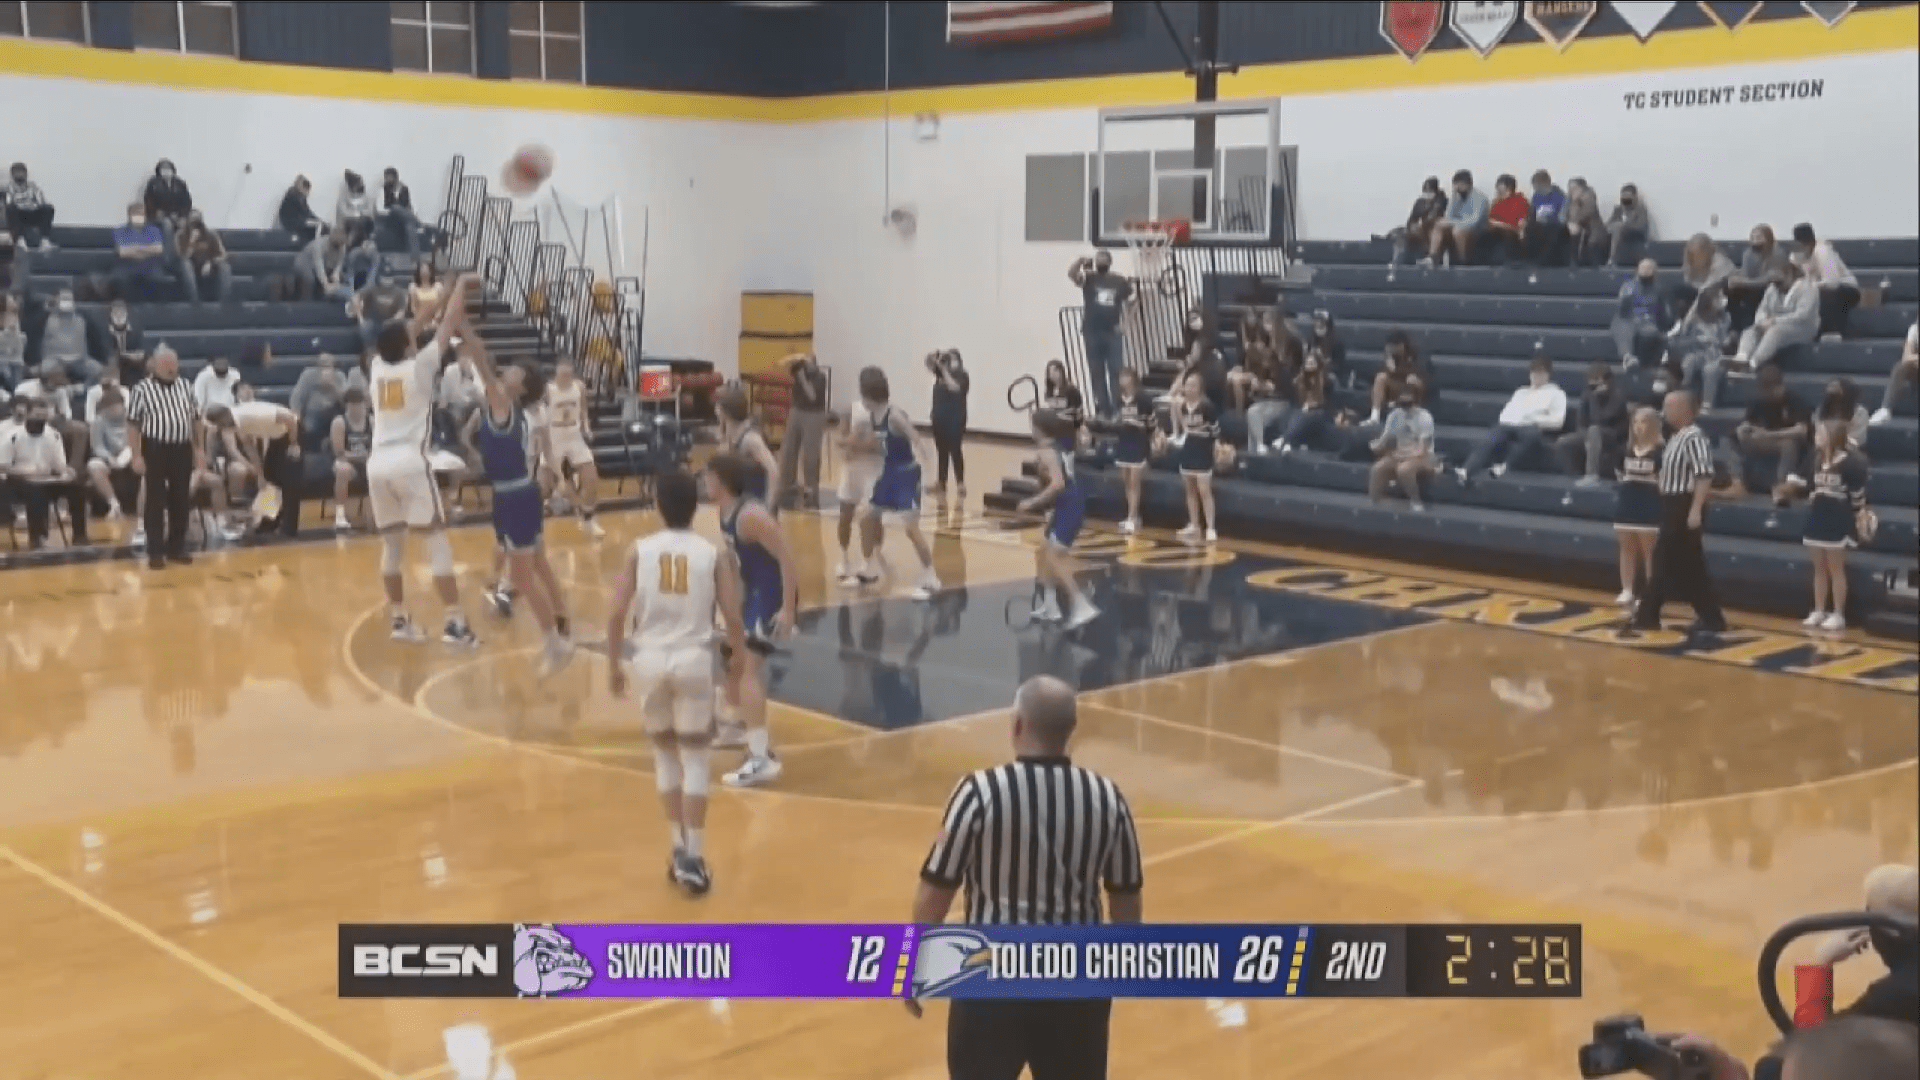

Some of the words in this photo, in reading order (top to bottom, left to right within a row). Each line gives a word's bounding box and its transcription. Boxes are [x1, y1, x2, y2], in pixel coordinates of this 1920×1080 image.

[1623, 91, 1646, 110] TC
[1649, 85, 1735, 108] STUDENT
[1739, 78, 1825, 103] SECTION
[658, 552, 689, 595] 11
